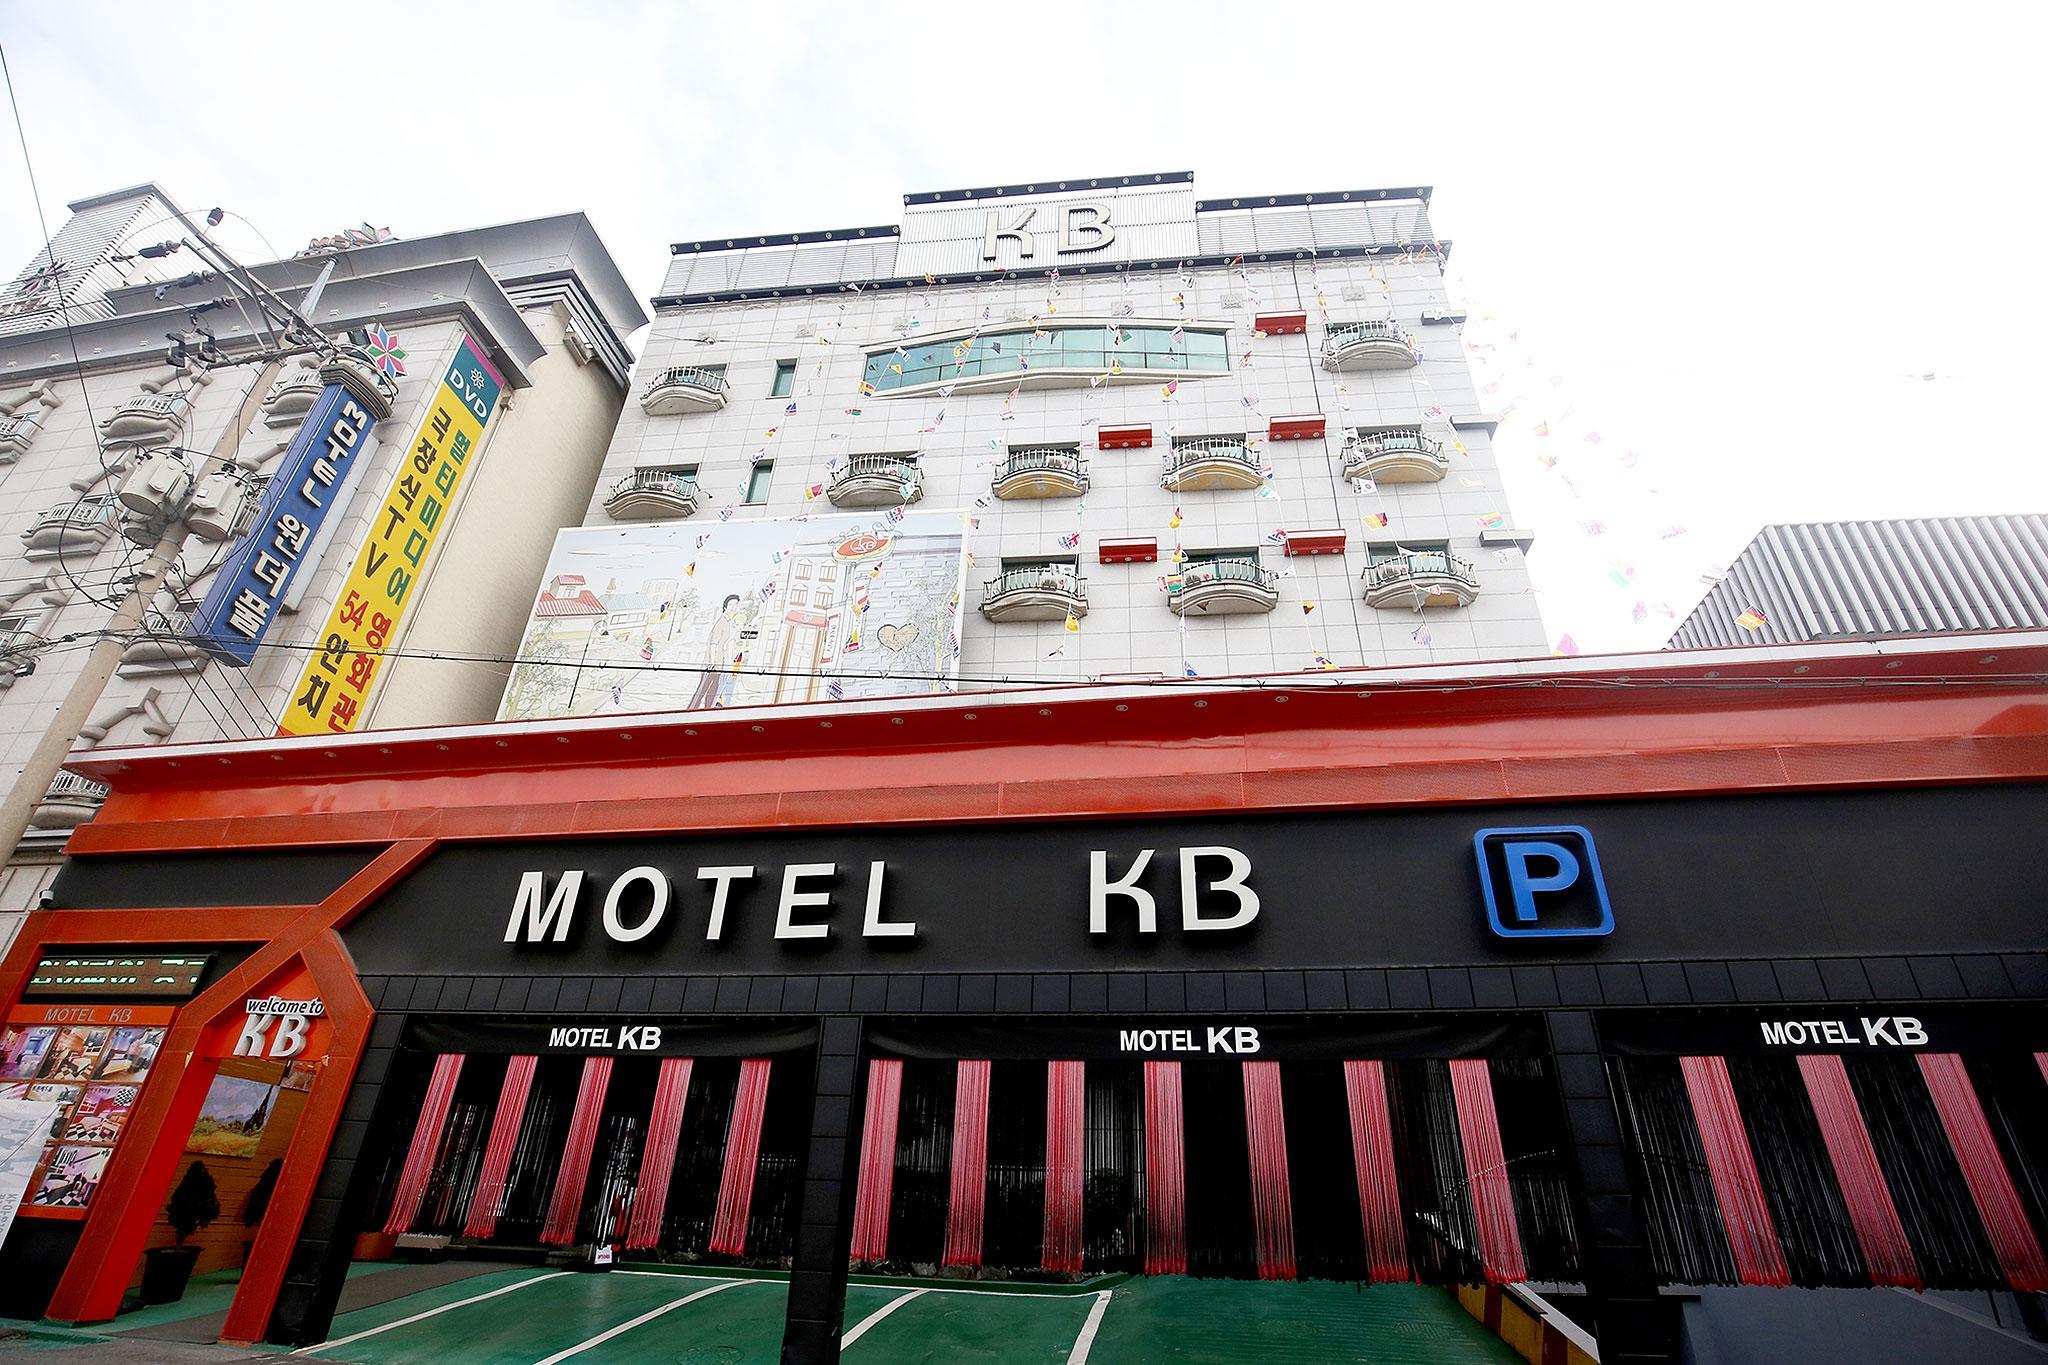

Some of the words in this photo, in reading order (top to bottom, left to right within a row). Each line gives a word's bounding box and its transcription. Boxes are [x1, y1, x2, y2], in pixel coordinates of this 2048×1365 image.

[983, 203, 1115, 261] KB
[449, 368, 488, 419] DVD
[301, 400, 368, 509] MOTEL
[386, 429, 471, 606] 멀티미디어
[228, 514, 311, 639] 원더풀
[328, 611, 392, 733] 영화관
[503, 859, 918, 943] MOTEL
[1089, 846, 1261, 934] KB
[1502, 842, 1580, 922] P
[44, 1008, 96, 1022] MOTEL
[108, 1008, 133, 1023] KB
[247, 997, 306, 1014] welcome
[309, 996, 324, 1014] to
[1760, 1020, 1860, 1045] MOTEL
[1861, 1016, 1929, 1046] KB
[232, 1013, 310, 1057] KB
[548, 1027, 613, 1048] MOTEL
[617, 1025, 661, 1050] KB
[1119, 1030, 1201, 1051] MOTEL
[1207, 1026, 1261, 1053] KB
